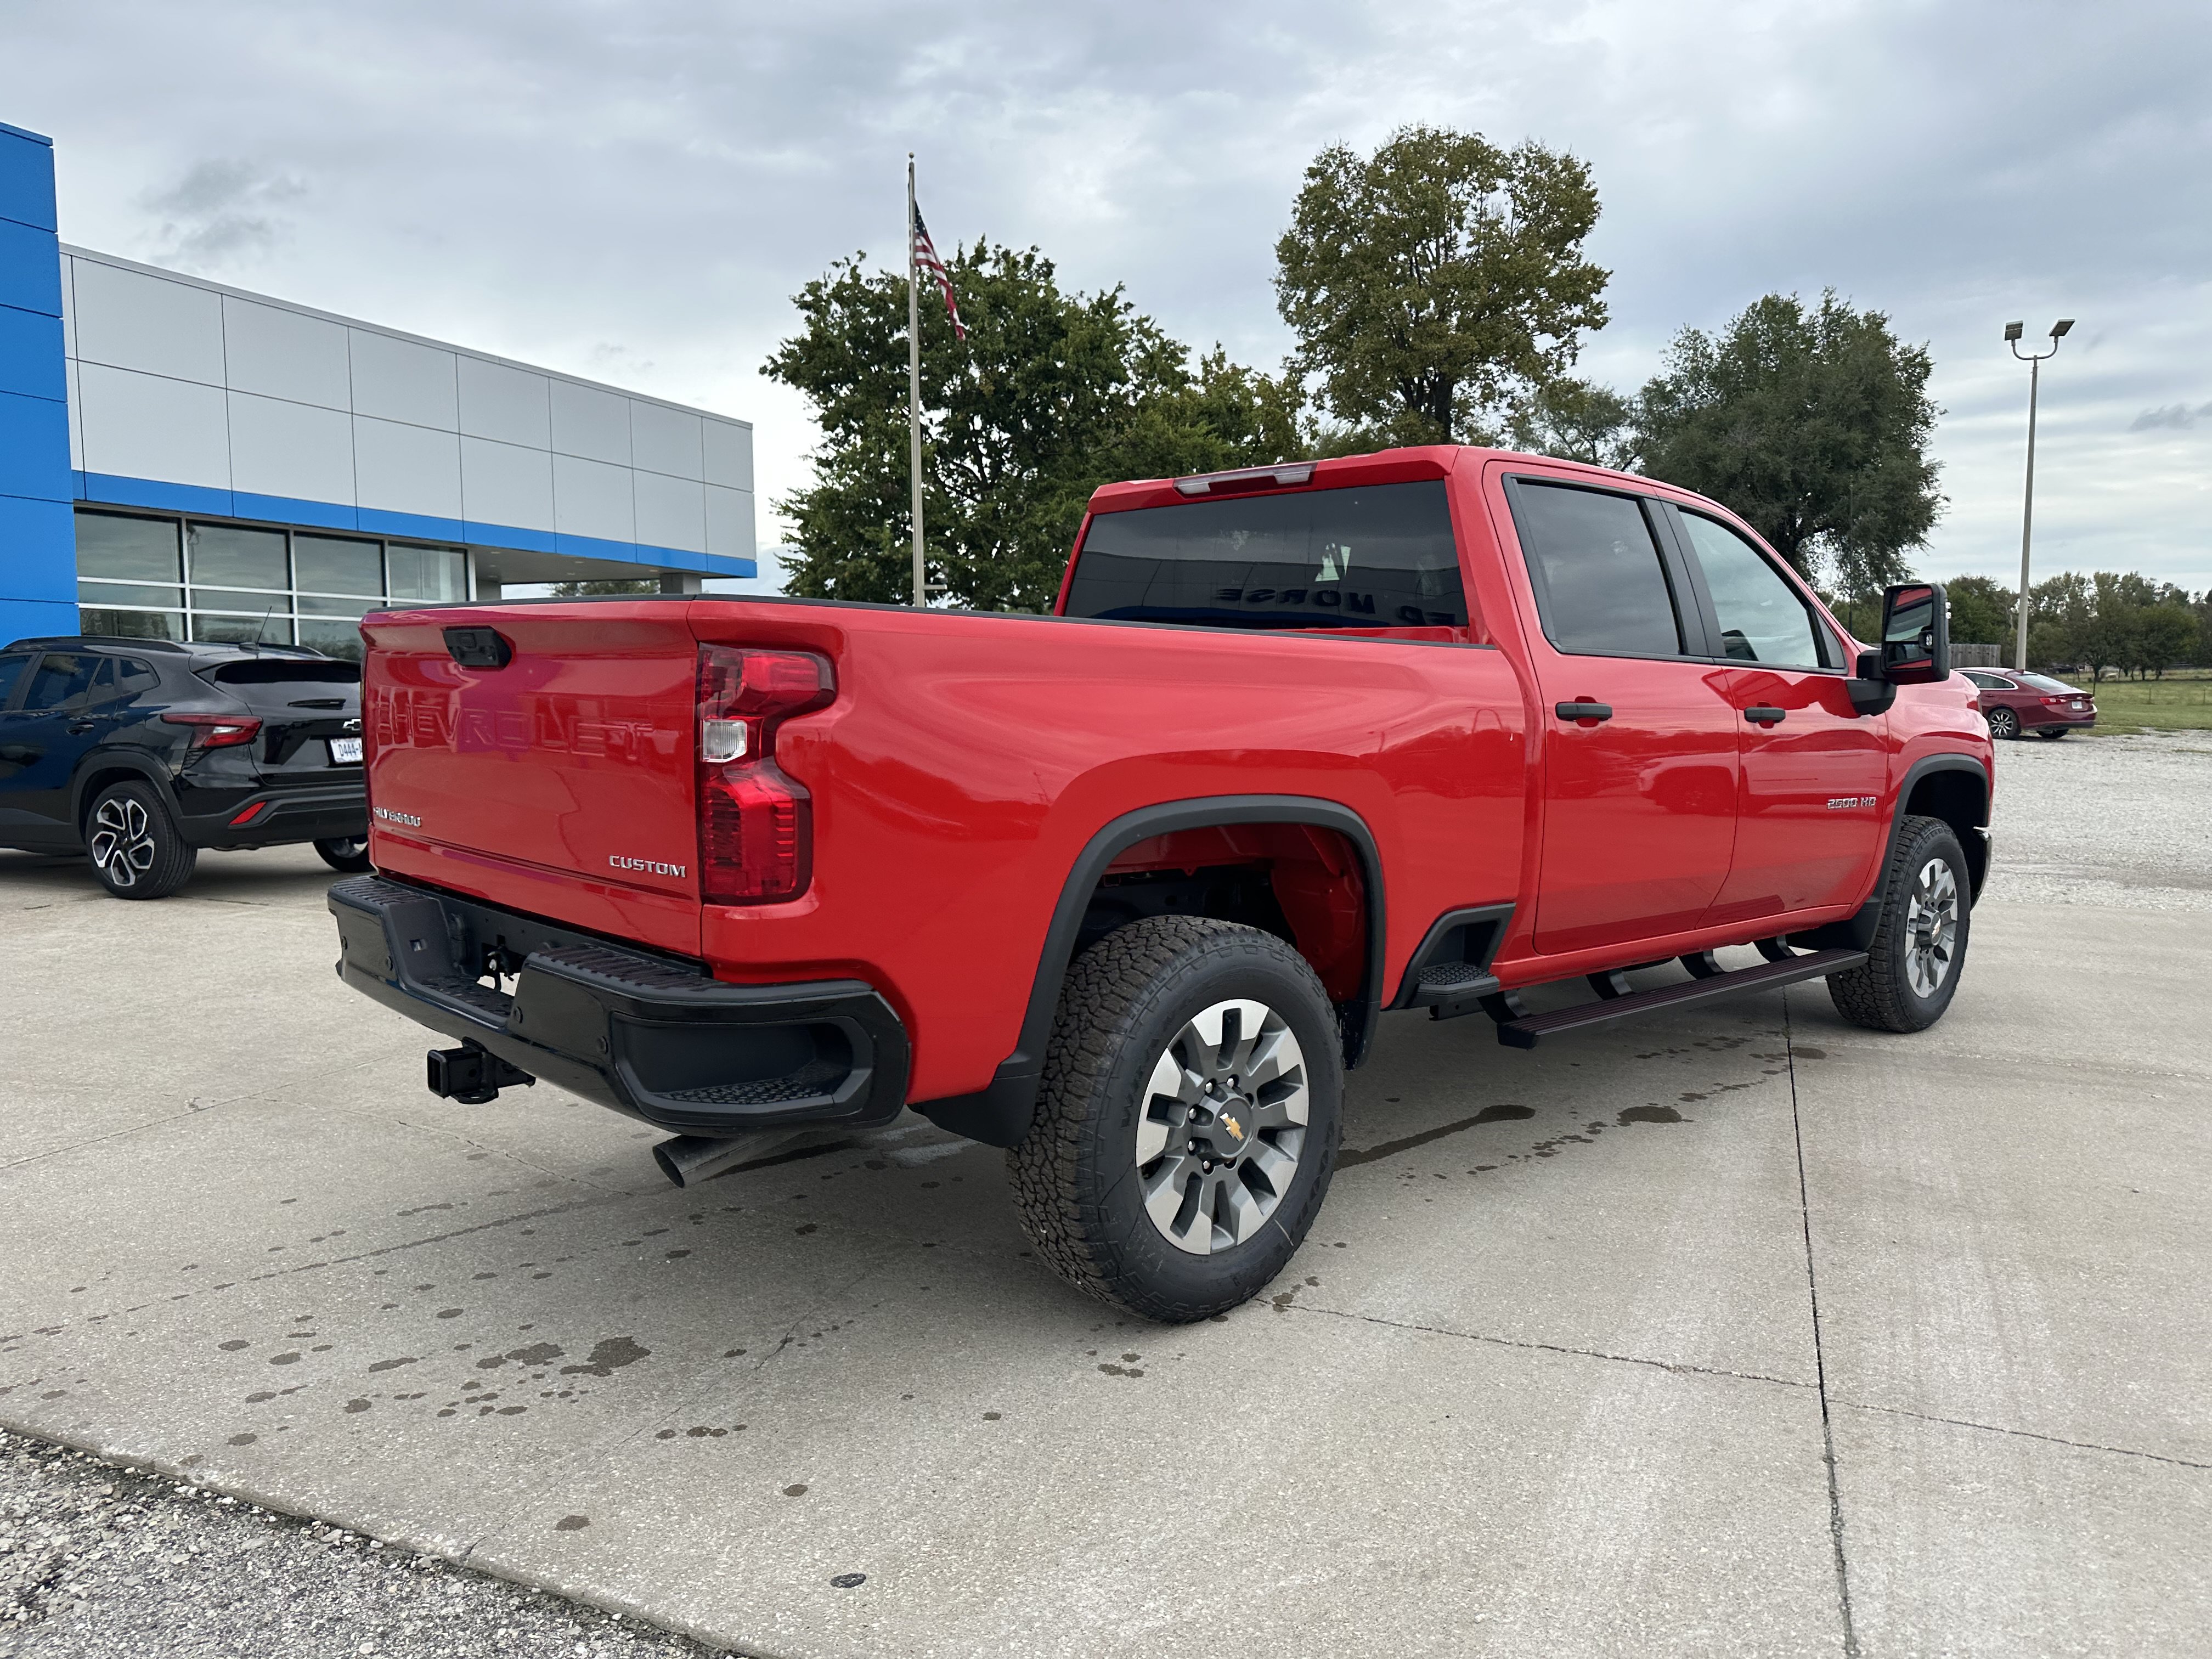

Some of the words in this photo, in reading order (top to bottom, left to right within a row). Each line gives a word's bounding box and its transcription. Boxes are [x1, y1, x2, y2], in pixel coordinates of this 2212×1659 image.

[375, 701, 653, 761] CHEVROLET
[1827, 797, 1858, 809] 2500
[1860, 797, 1876, 807] HD
[609, 855, 686, 878] CUSTOM
